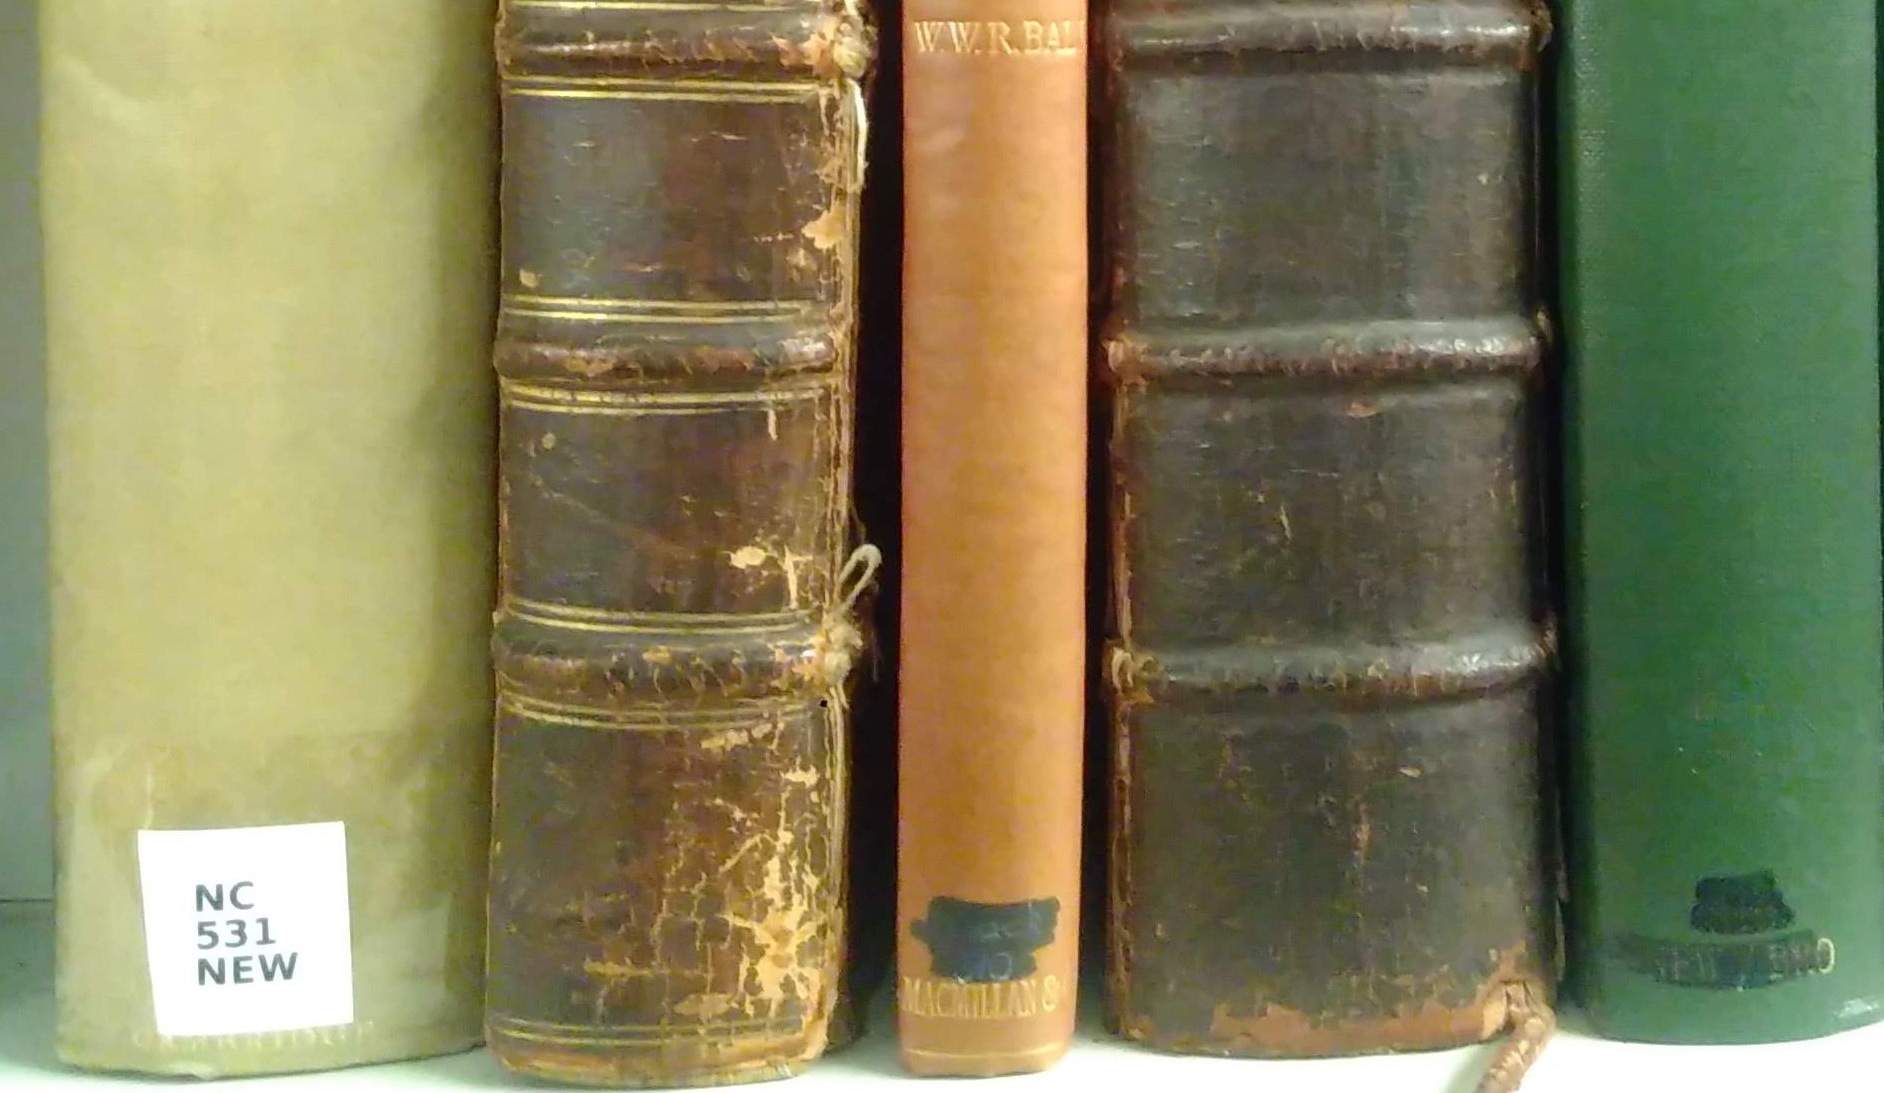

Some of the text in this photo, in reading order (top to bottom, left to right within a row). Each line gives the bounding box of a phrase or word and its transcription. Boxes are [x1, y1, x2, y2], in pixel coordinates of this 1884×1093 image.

[195, 881, 255, 912] NC
[197, 917, 276, 950] 531
[197, 952, 298, 986] NEW
